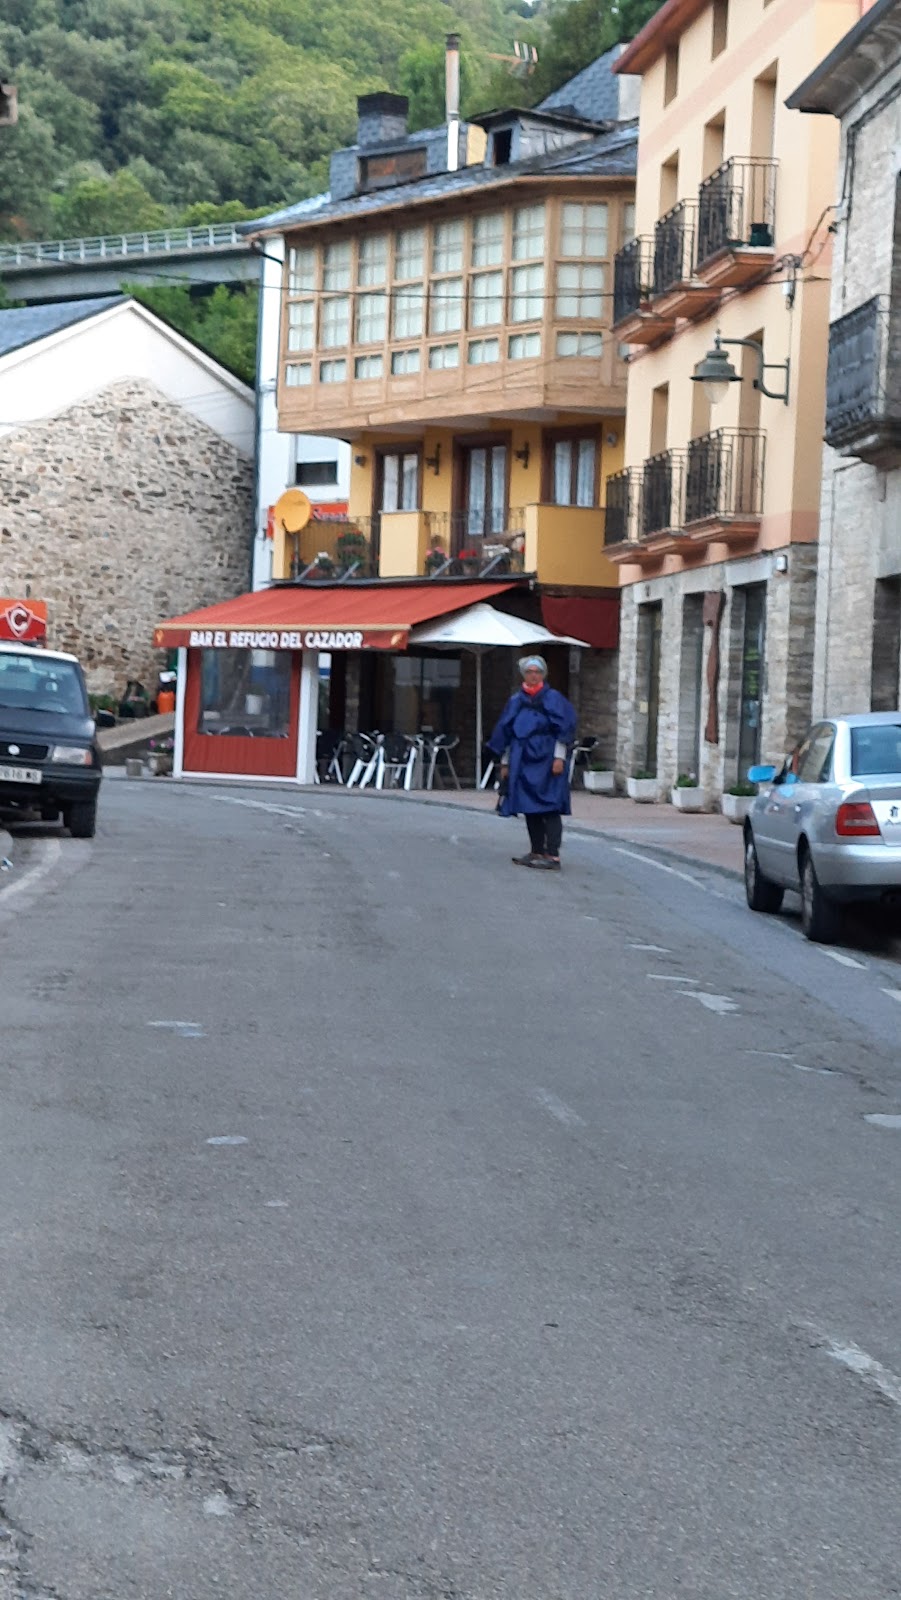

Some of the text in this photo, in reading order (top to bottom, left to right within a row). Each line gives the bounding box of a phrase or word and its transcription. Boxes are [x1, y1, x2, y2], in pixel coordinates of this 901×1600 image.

[11, 608, 28, 632] C
[190, 630, 363, 649] BAR EL REFUGIO DEL CAZADOR
